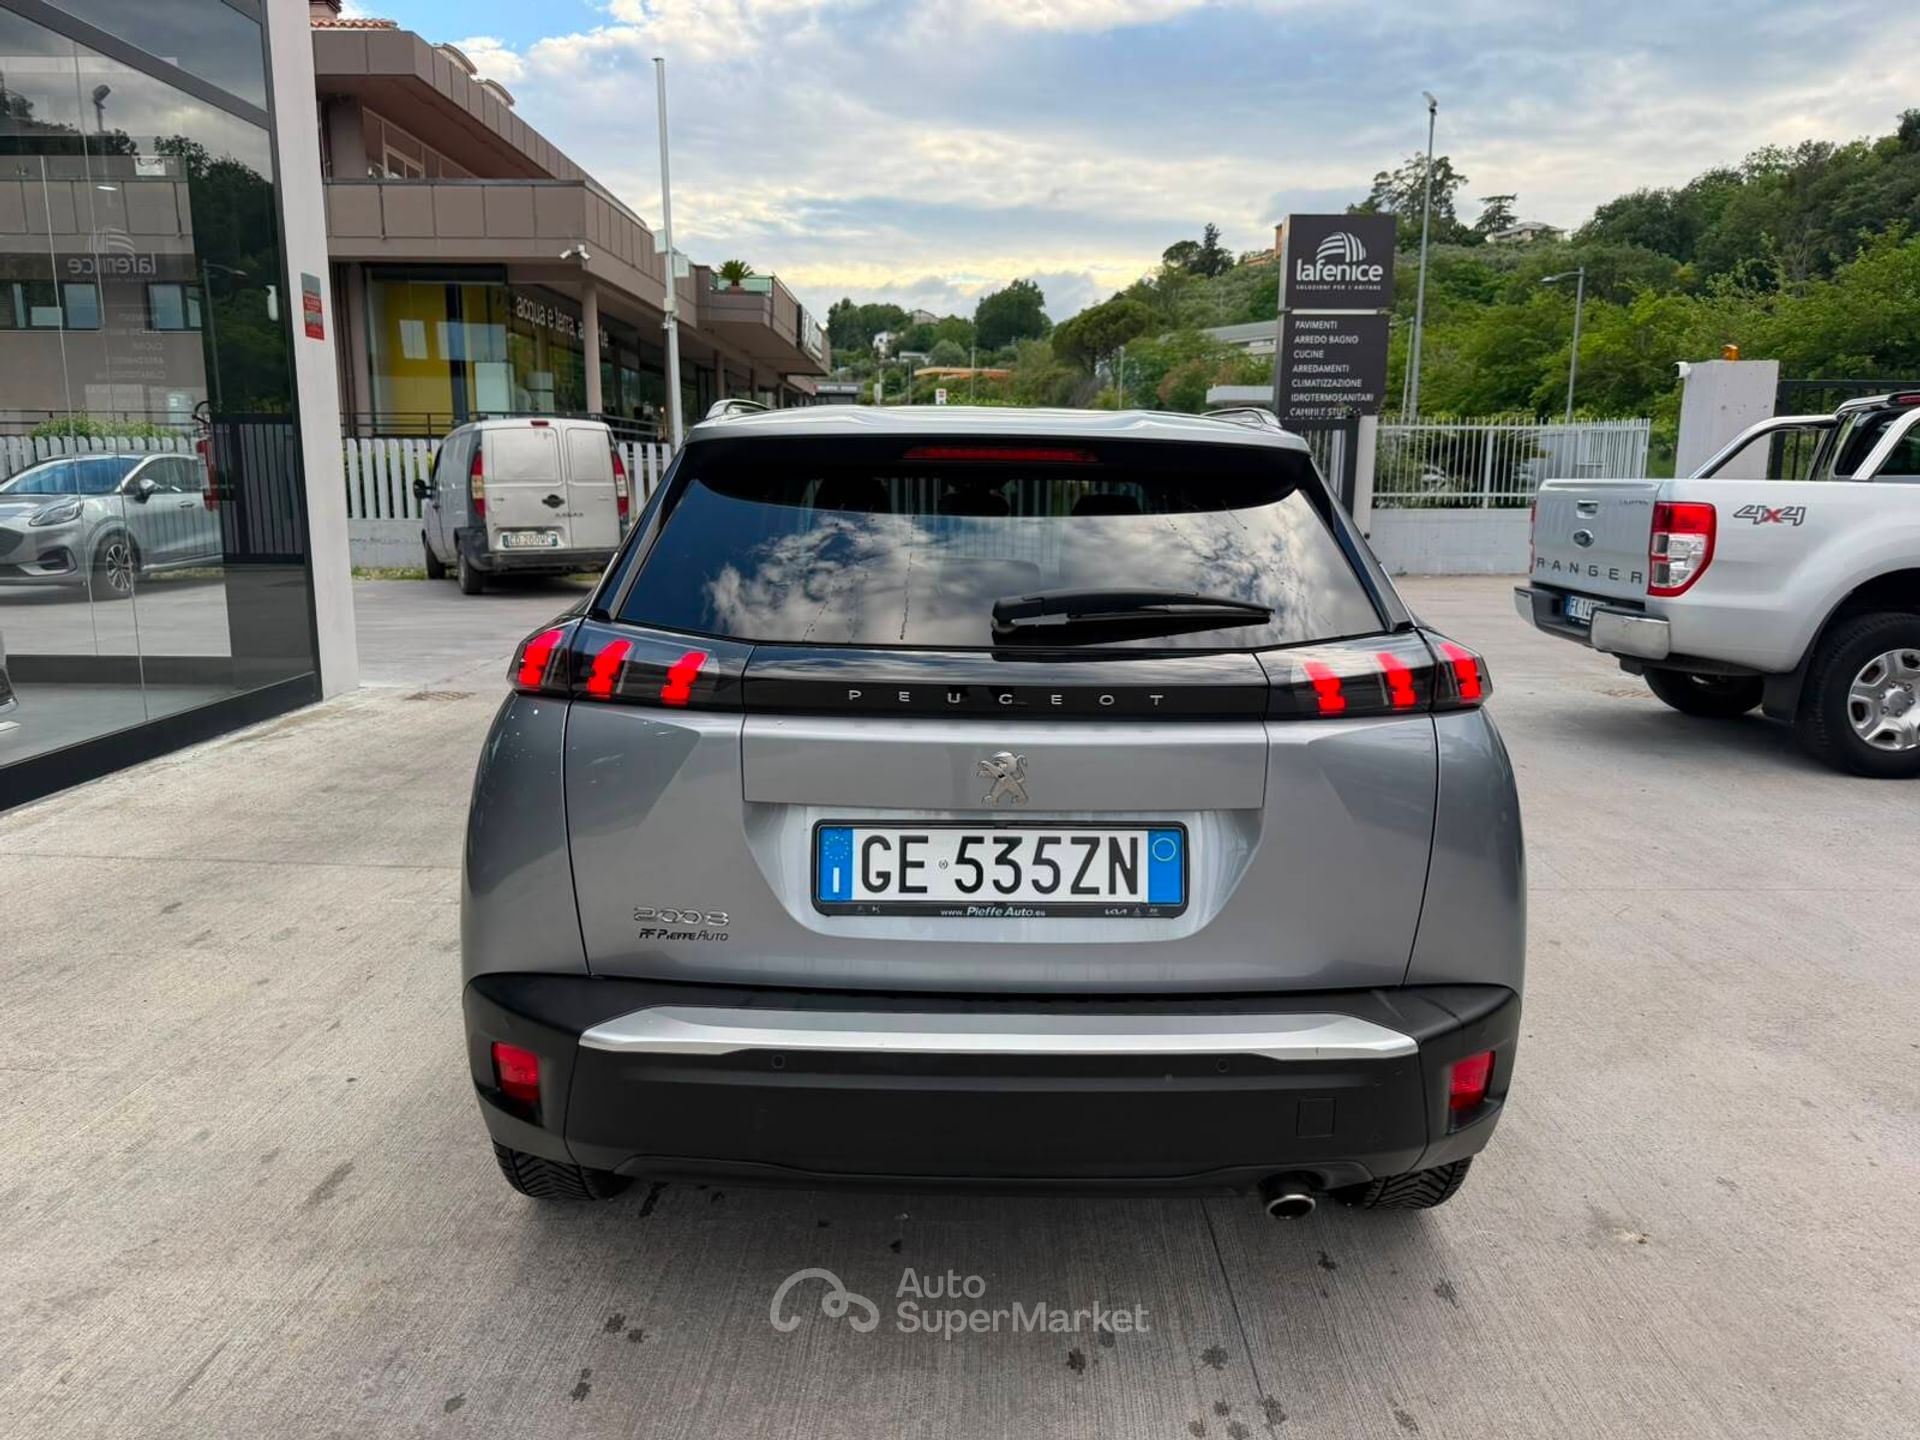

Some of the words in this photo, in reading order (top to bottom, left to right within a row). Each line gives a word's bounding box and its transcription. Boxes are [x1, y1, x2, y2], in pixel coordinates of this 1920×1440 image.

[1296, 259, 1383, 281] lafenice
[516, 297, 546, 328] acqua
[547, 308, 554, 328] e
[1295, 320, 1338, 330] PAVIMENTI
[1294, 335, 1327, 344] ARREDO
[1329, 335, 1359, 344] BAGNO
[1293, 350, 1325, 359] CUCINE
[1292, 364, 1349, 373] ARREDAMENTI
[1291, 379, 1362, 388] CLIMATIZZAZIONE
[1291, 393, 1374, 402] IDROTERMOSANITARI
[1536, 557, 1642, 585] RANGER
[848, 689, 1164, 706] PEUGEOT
[861, 835, 929, 894] GE
[954, 836, 1138, 896] 535ZN
[633, 906, 730, 926] 2008
